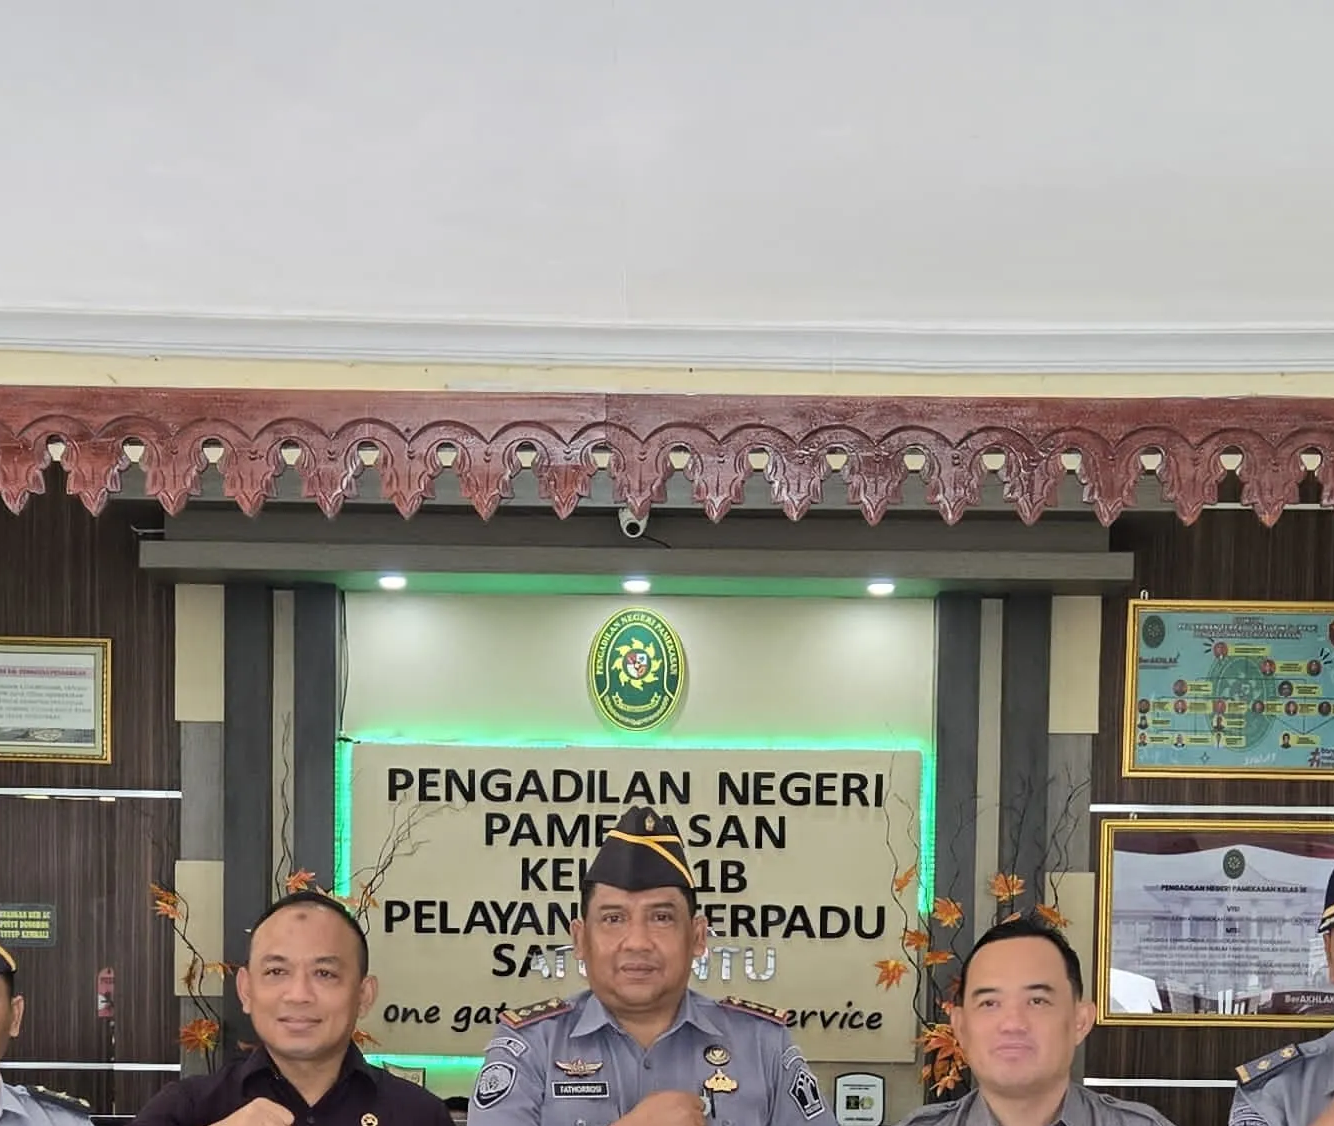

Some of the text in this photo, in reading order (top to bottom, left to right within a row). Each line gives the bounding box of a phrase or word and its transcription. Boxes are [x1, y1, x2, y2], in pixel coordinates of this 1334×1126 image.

[388, 767, 885, 808] PENGADILAN NEGERI
[485, 811, 787, 850] PAMEASAN
[694, 859, 747, 894] 1B
[384, 900, 886, 940] PELAYAN ERPADU
[492, 943, 588, 982] SAT
[383, 1000, 884, 1034] one gat ervice
